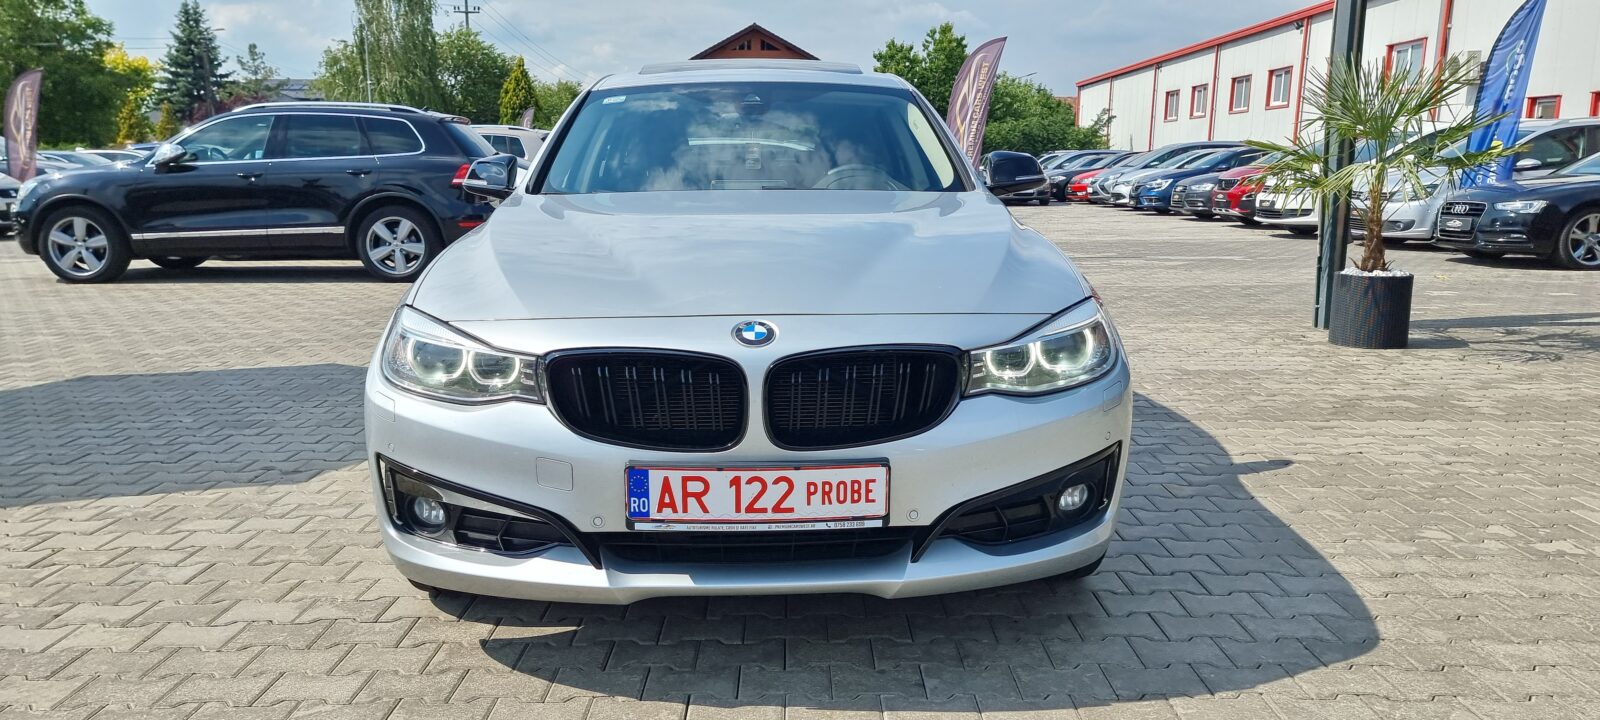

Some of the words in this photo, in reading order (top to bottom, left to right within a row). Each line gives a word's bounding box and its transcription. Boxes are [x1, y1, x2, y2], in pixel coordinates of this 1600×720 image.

[973, 91, 983, 119] CARS
[978, 62, 990, 90] WEST
[630, 498, 649, 513] RO
[656, 475, 711, 514] AR
[729, 475, 795, 514] 122
[806, 479, 877, 506] PROBE
